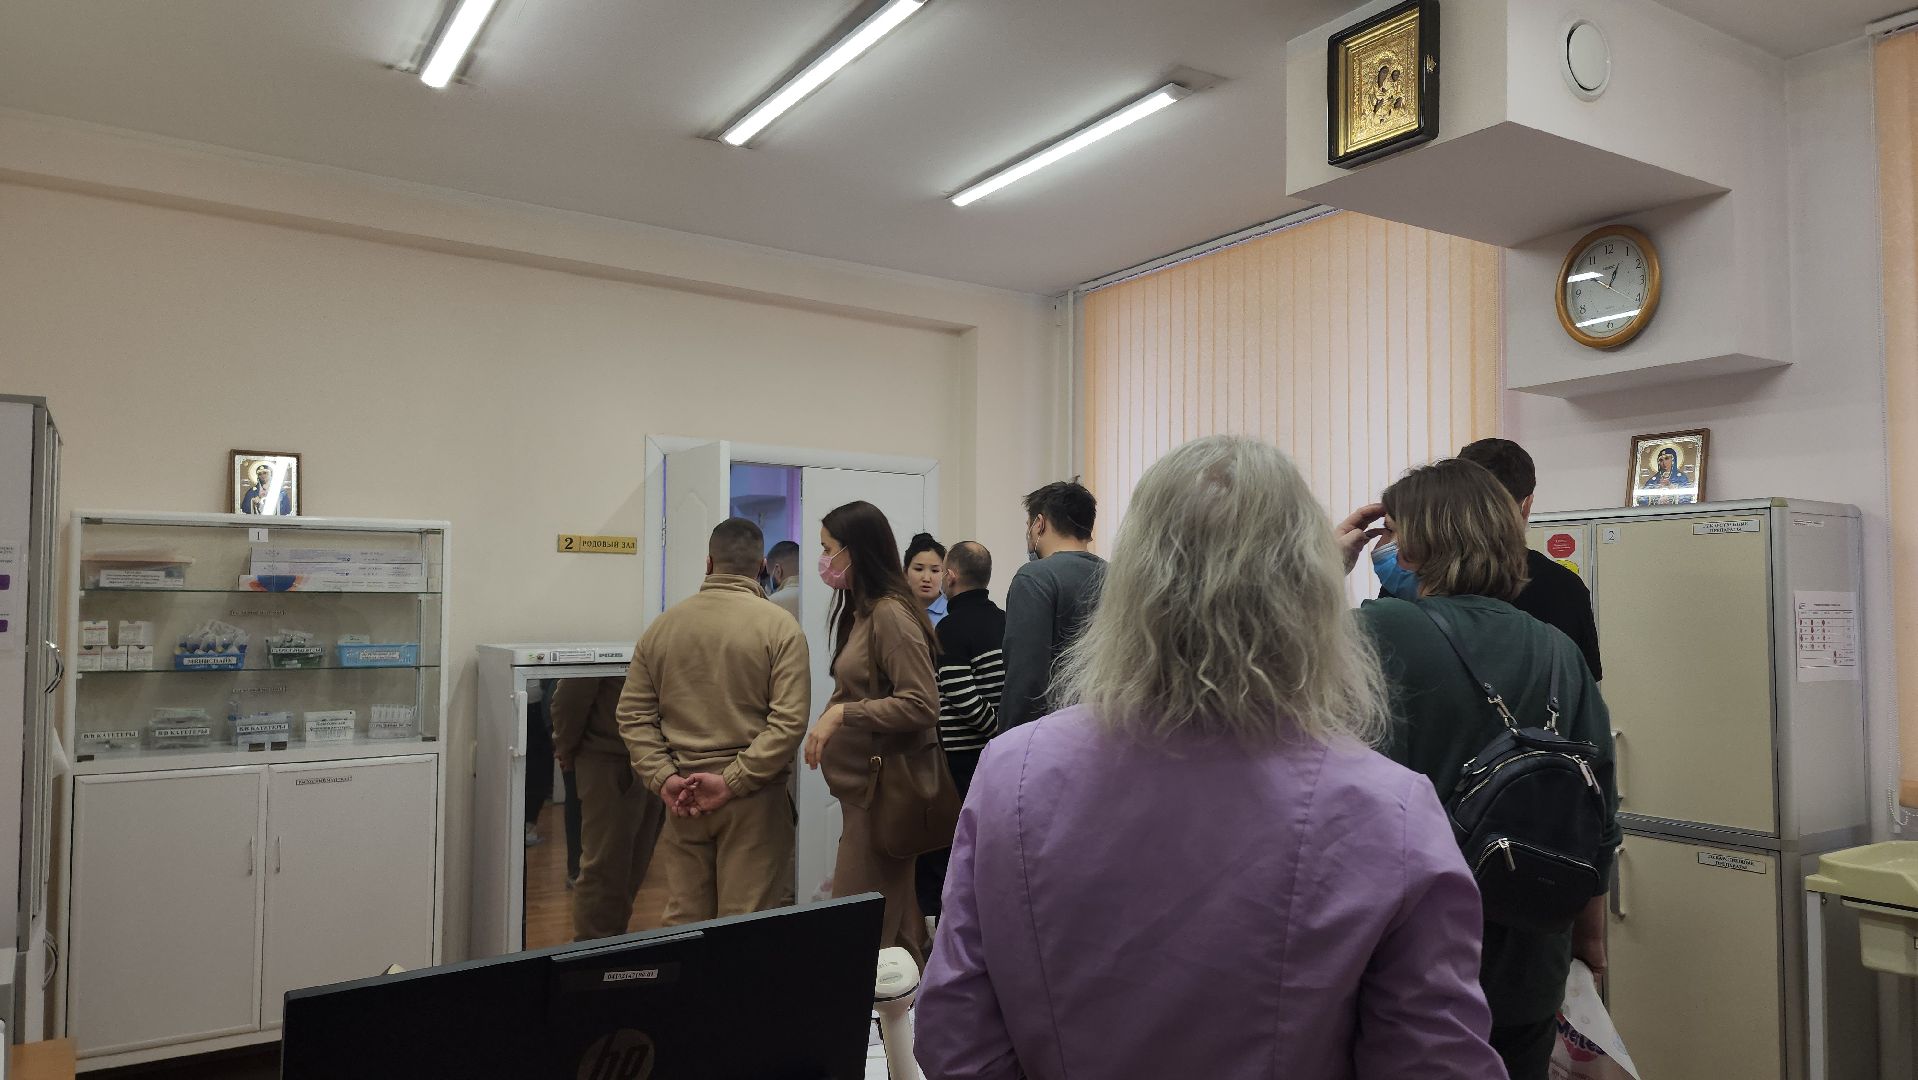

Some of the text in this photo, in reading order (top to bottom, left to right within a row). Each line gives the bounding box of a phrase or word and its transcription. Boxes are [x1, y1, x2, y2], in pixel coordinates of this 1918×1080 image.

[1604, 244, 1614, 255] 12
[1589, 256, 1596, 265] 11
[1635, 258, 1641, 270] 2
[1639, 274, 1645, 285] 3
[1575, 288, 1582, 298] 9
[1579, 304, 1587, 315] 8
[1608, 530, 1615, 541] 2
[564, 537, 635, 550] 2 РОДОВЫЙ ЗАЛ
[588, 1032, 649, 1080] hp
